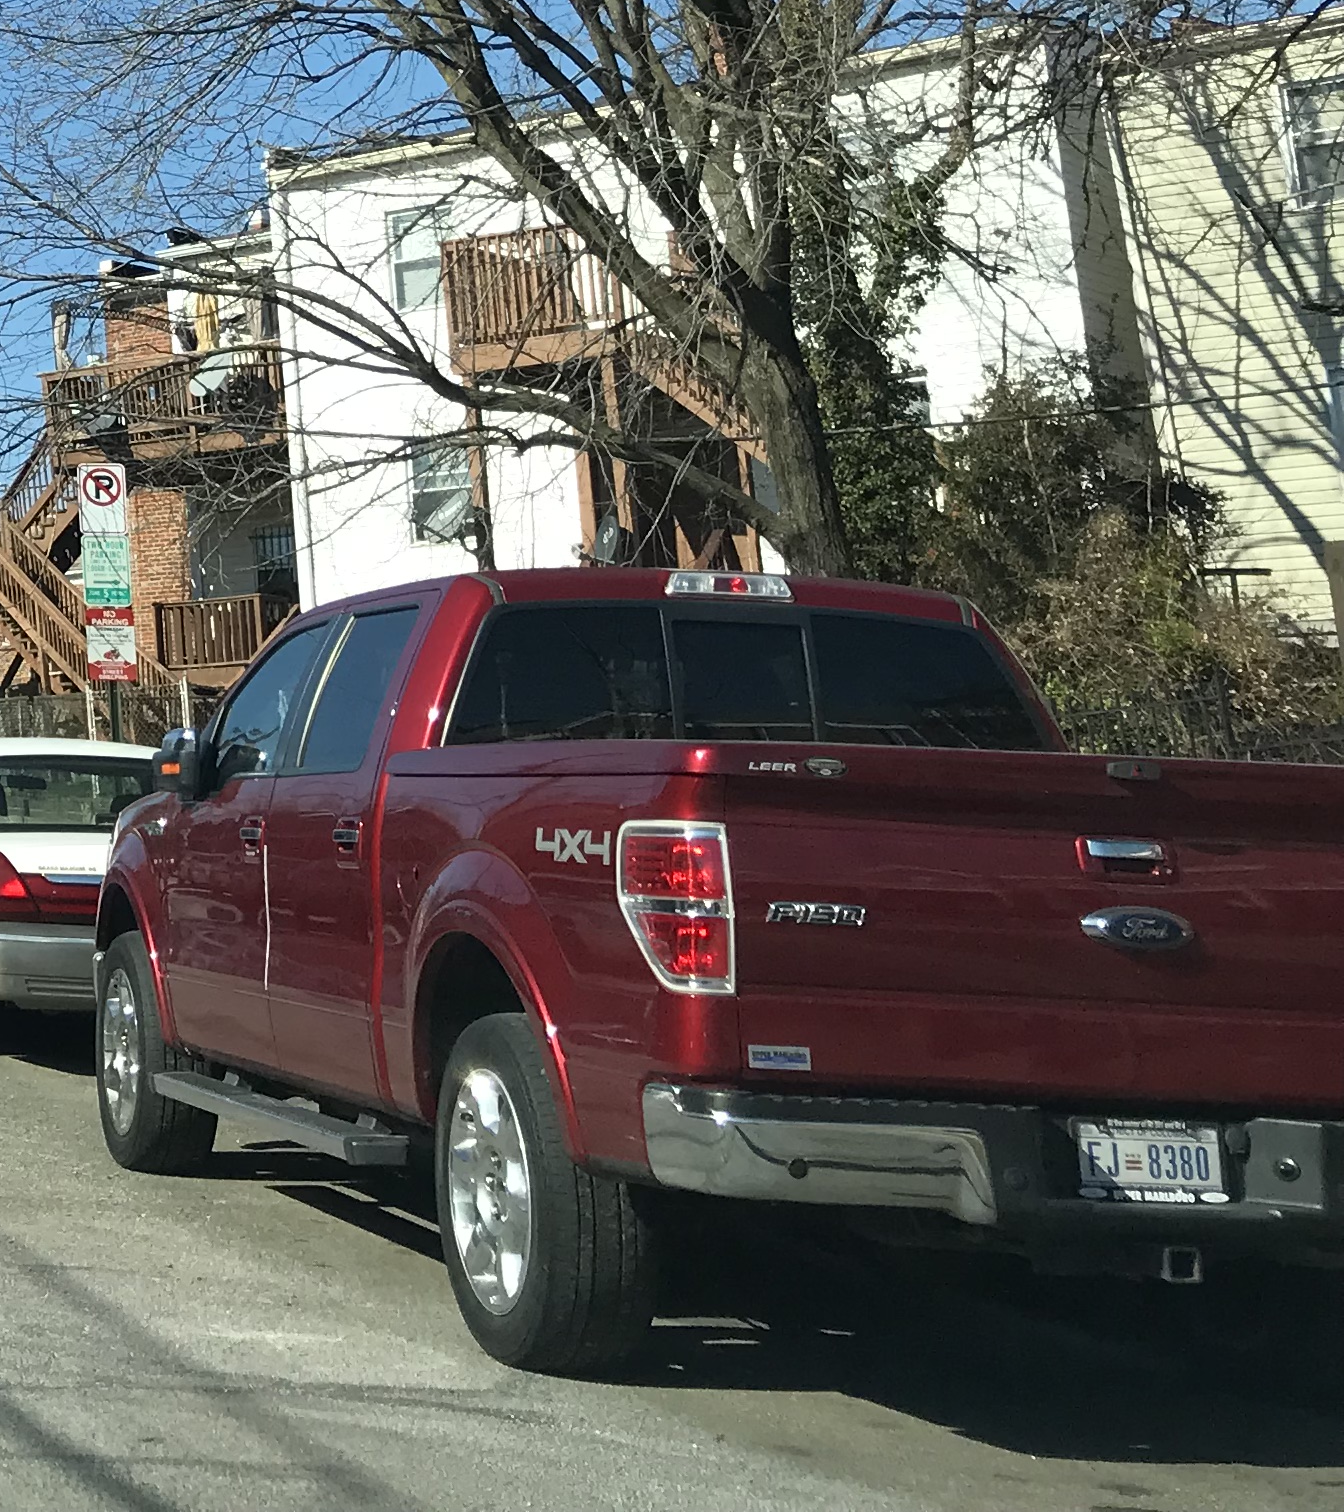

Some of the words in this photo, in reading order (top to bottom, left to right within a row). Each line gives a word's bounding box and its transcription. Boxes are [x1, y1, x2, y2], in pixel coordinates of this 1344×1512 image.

[102, 610, 116, 618] NO
[91, 618, 129, 626] PARKING
[748, 761, 796, 772] LEER
[1087, 1141, 1120, 1177] FJ
[1147, 1144, 1210, 1181] 8380
